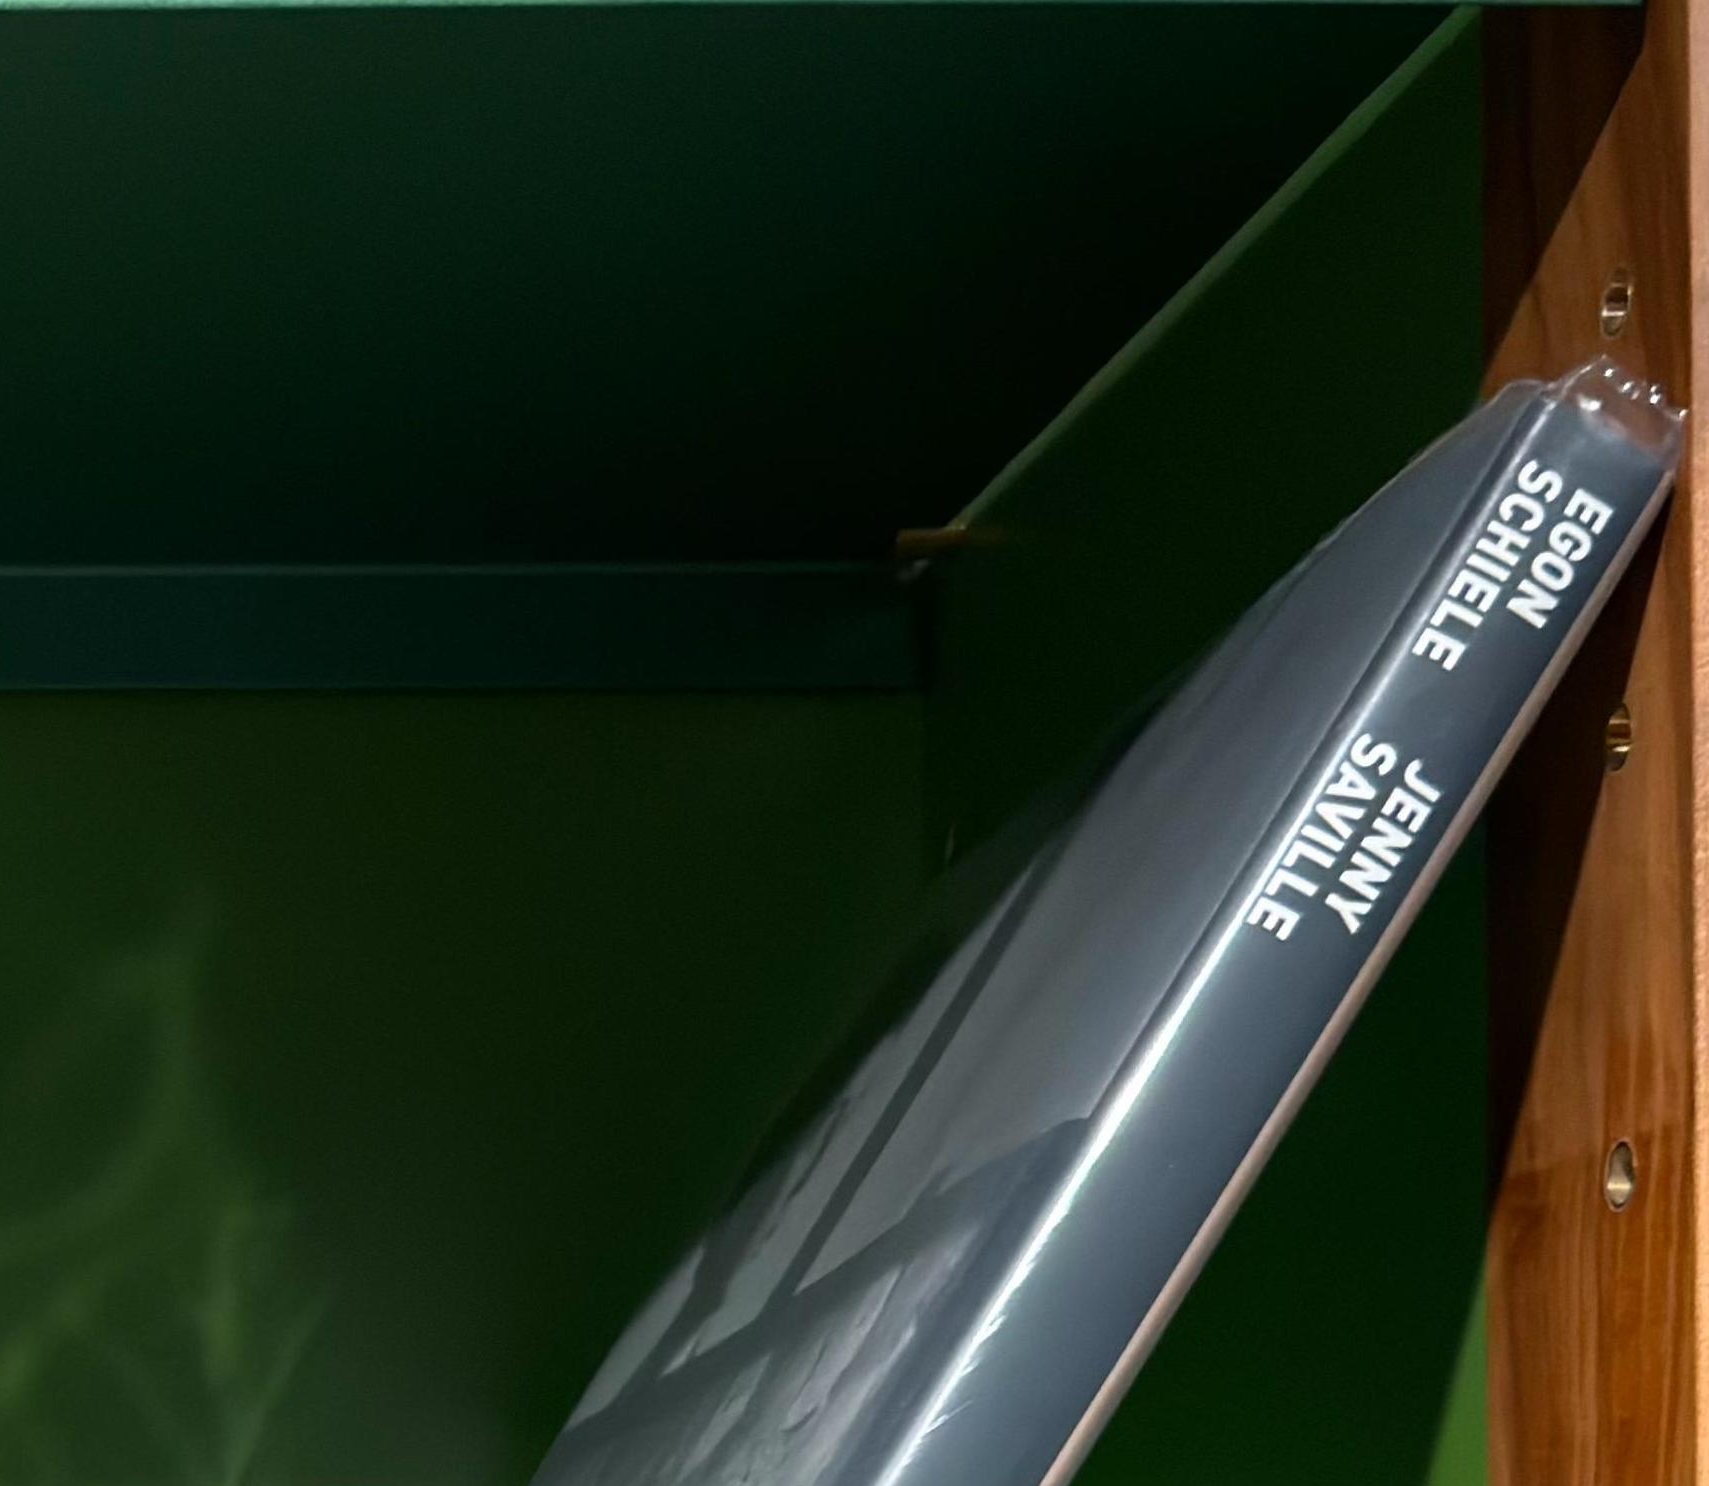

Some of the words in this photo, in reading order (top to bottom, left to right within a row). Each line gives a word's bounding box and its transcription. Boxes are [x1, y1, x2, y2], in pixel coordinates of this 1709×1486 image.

[1412, 460, 1562, 671] SCHIELE
[1507, 487, 1614, 629] EGON
[1247, 733, 1399, 942] SAVILLE
[1325, 758, 1441, 935] JENNY
